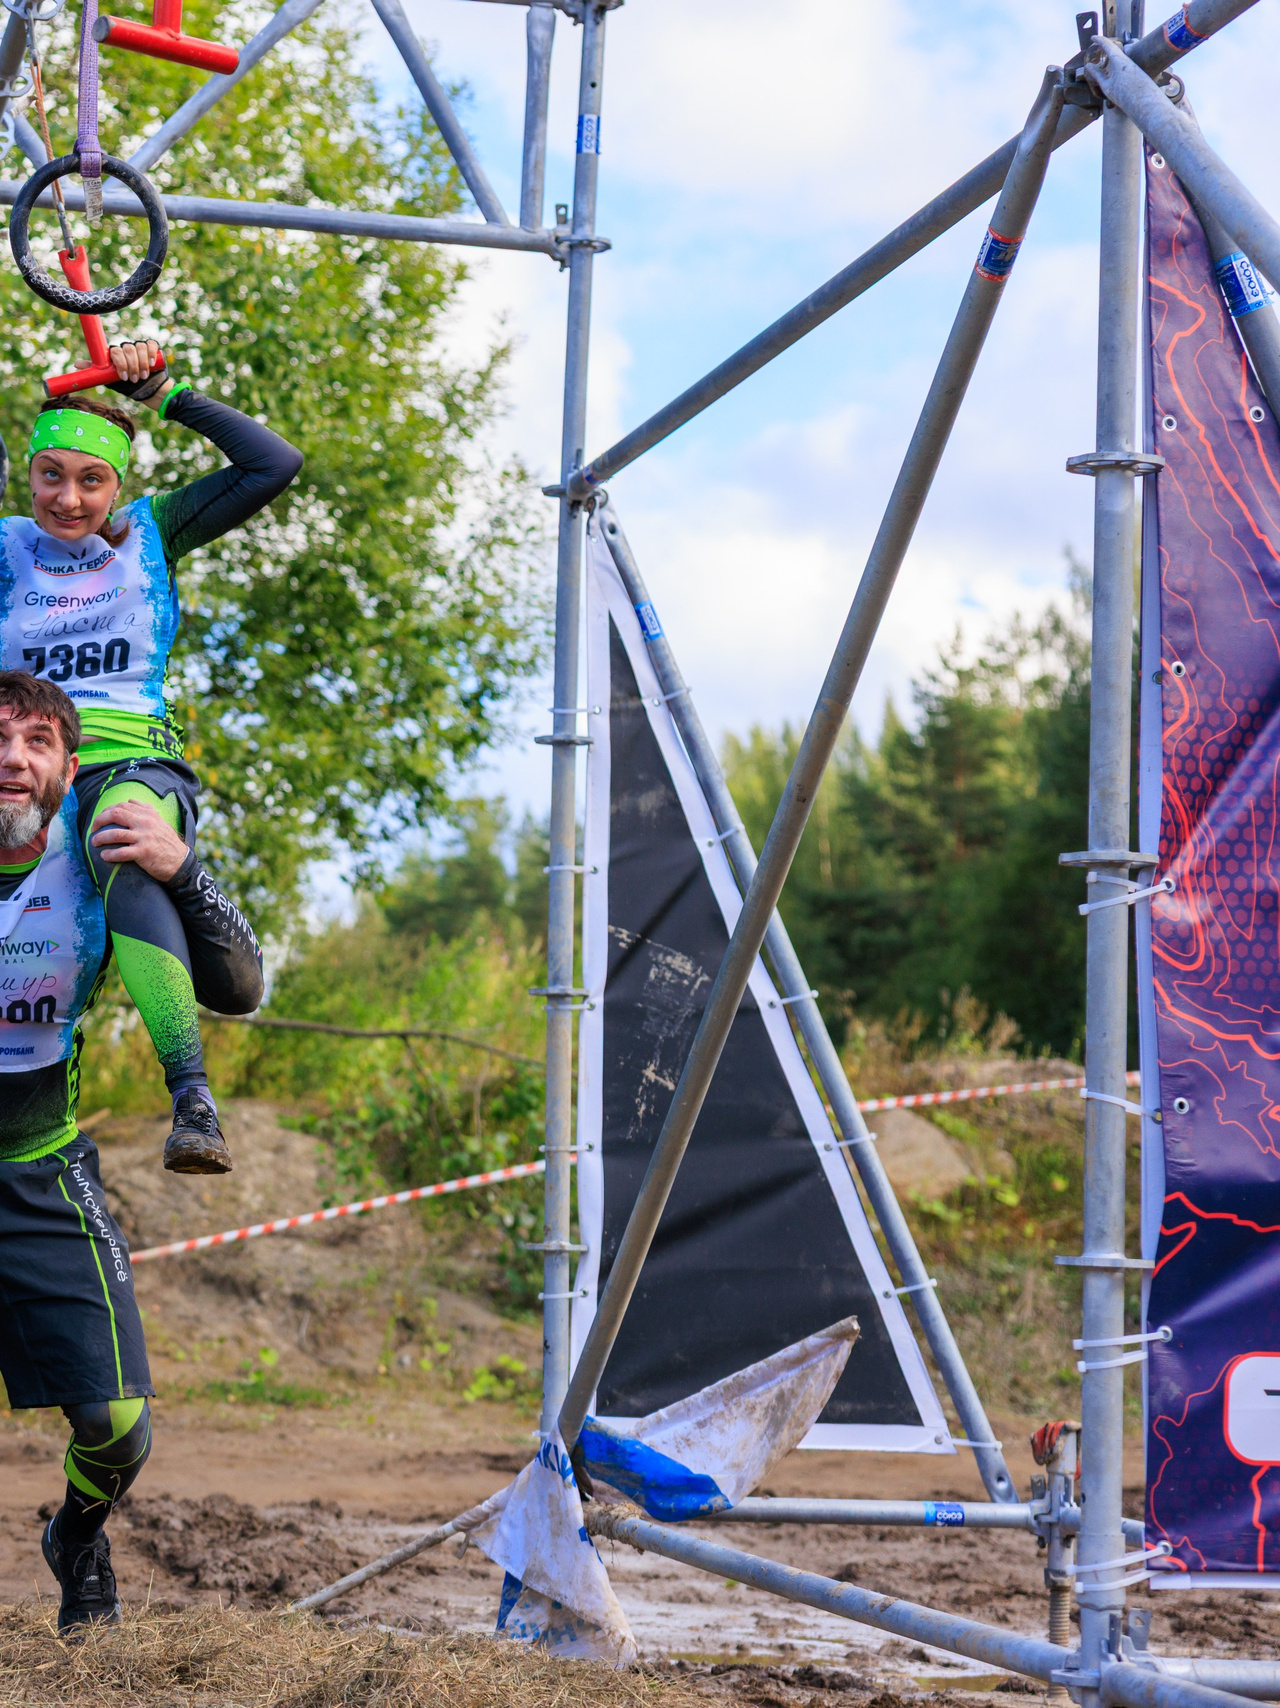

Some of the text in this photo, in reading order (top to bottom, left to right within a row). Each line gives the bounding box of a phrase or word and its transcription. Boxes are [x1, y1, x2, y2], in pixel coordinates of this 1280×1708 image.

[1240, 261, 1259, 298] СОЮЗ
[34, 549, 116, 574] ГОНКА ГЕРОЕВ
[24, 588, 114, 608] Greenway
[54, 606, 96, 616] GLOBAL
[23, 638, 130, 682] 7360
[65, 690, 110, 698] ПРОМБАНК
[204, 908, 247, 951] GLOBAL
[936, 1511, 963, 1520] СОЮЗ
